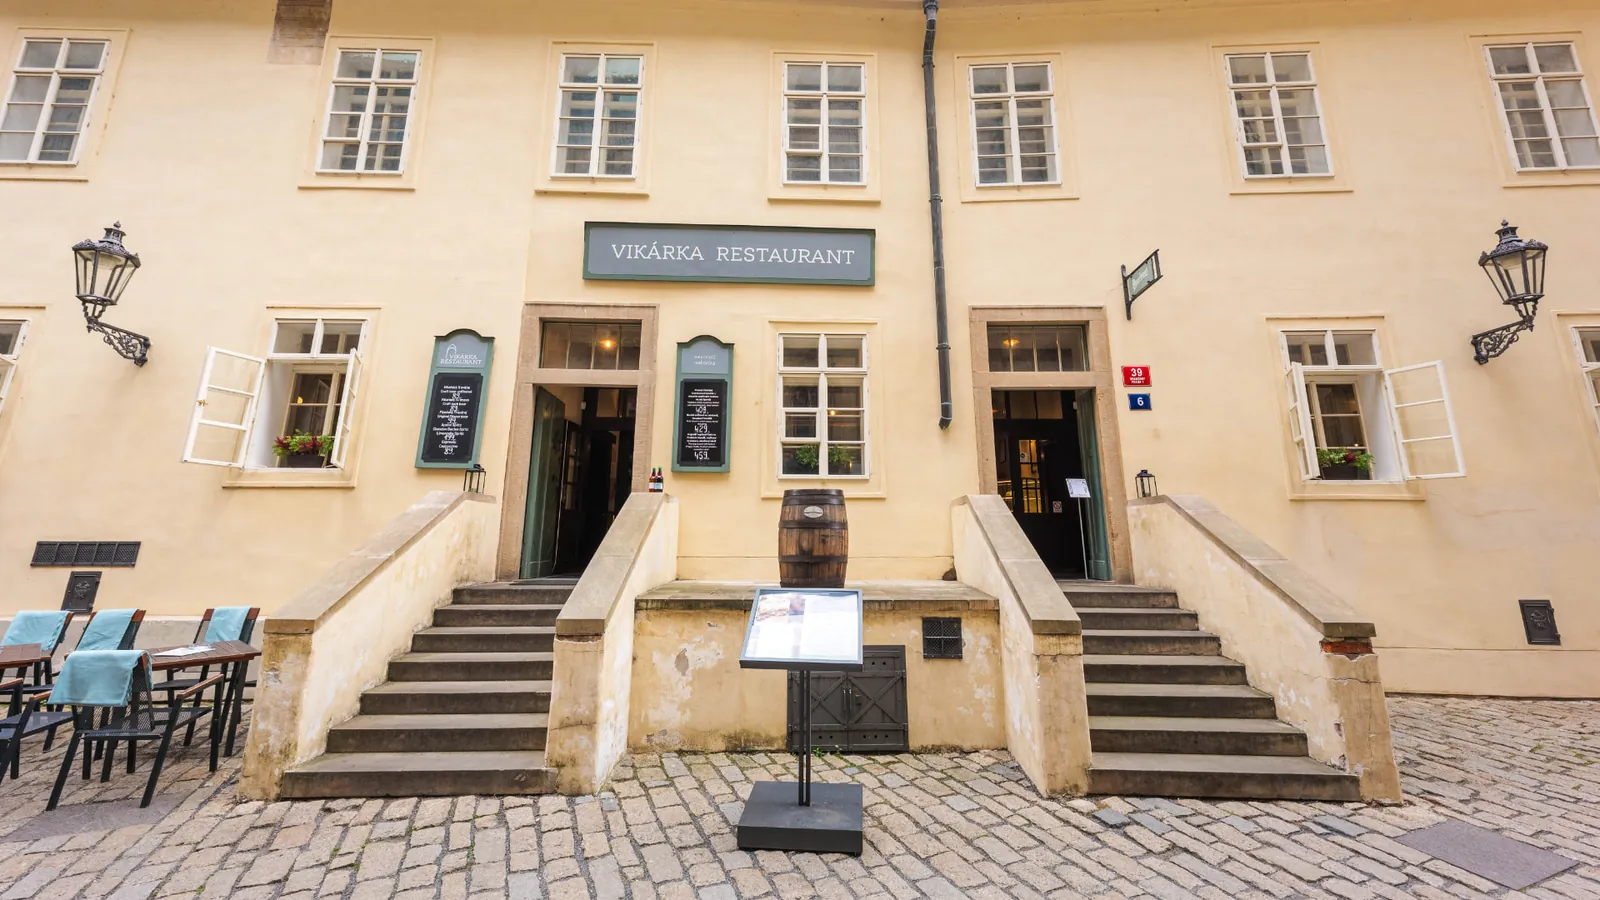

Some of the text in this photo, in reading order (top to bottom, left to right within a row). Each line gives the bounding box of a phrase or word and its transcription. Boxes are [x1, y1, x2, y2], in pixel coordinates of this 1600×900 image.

[611, 241, 855, 265] VIKÁRKA RESTAURANT
[1130, 367, 1143, 377] 39
[1137, 396, 1144, 407] 6
